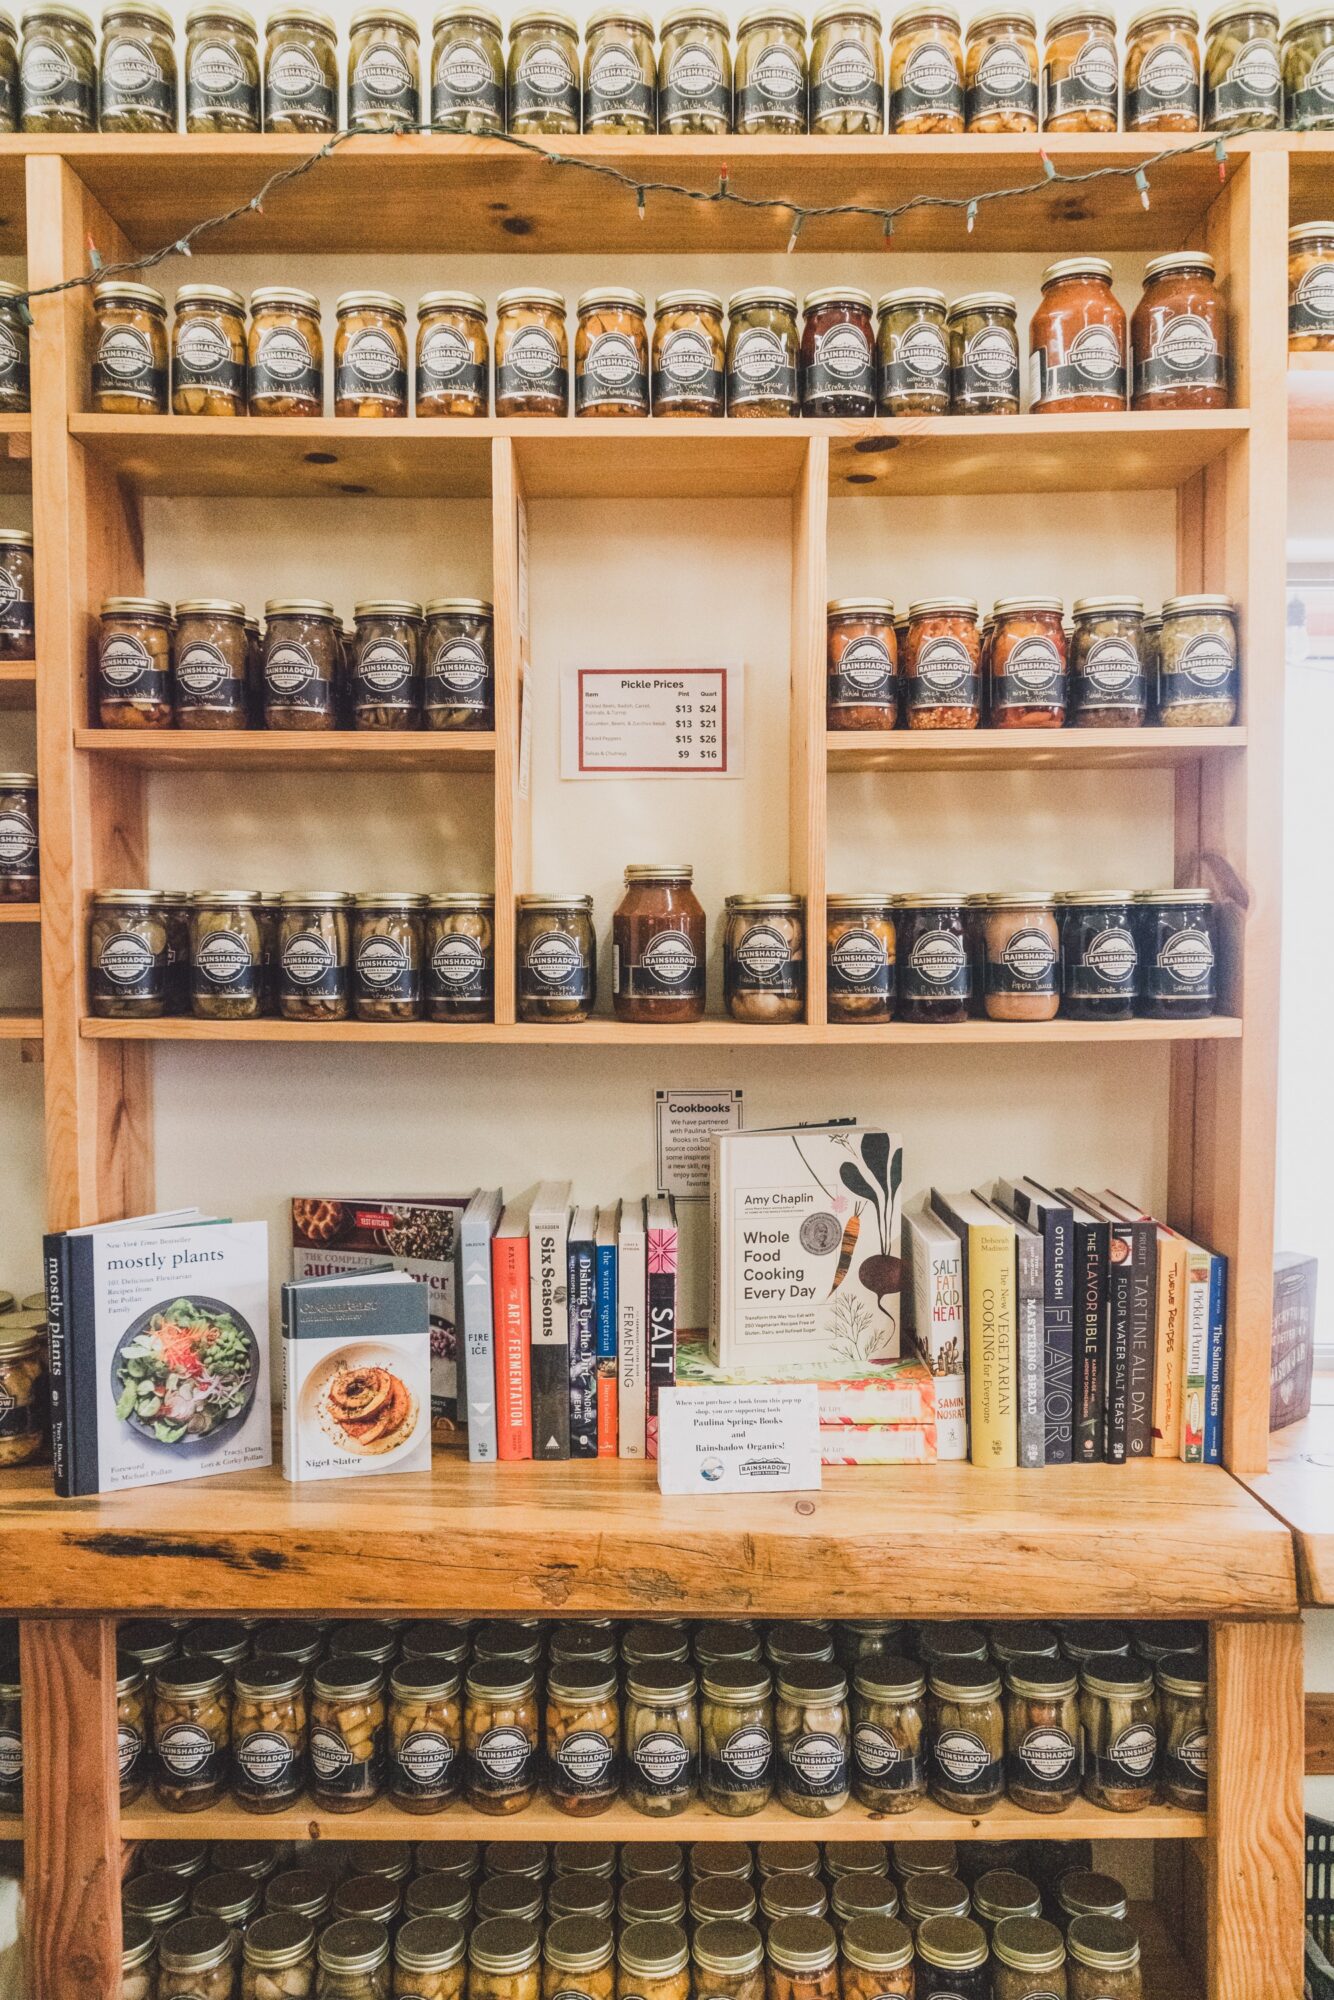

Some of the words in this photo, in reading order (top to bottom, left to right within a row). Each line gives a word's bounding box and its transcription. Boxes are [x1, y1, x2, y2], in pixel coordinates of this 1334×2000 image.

[520, 65, 573, 80] RAINSHADOW
[669, 67, 721, 82] RAINSHADOW
[752, 68, 803, 84] RAINSHADOW
[822, 63, 876, 79] RAINSHADOW
[1158, 339, 1214, 354] RAINSHADOW
[99, 350, 151, 366] RAINSHADOW
[347, 351, 400, 366] RAINSHADOW
[508, 350, 560, 365] RAINSHADOW
[660, 354, 713, 369] RAINSHADOW
[360, 664, 411, 674] RAINSHADOW
[435, 664, 487, 674] RAINSHADOW
[841, 662, 891, 672] RAINSHADOW
[918, 662, 970, 673] RAINSHADOW
[1009, 662, 1060, 672] RAINSHADOW
[1086, 663, 1138, 673] RAINSHADOW
[1181, 659, 1232, 670] RAINSHADOW
[621, 680, 651, 689] Pickle
[653, 680, 684, 689] Prices
[675, 704, 693, 714] $13
[699, 704, 717, 714] $24
[675, 719, 693, 729] $13
[700, 719, 717, 729] $21
[675, 735, 693, 744] $15
[699, 735, 717, 744] $26
[678, 750, 690, 759] $9
[699, 750, 717, 759] $16
[100, 956, 153, 965] RAINSHADOW
[283, 956, 331, 965] RAINSHADOW
[433, 958, 483, 966] RAINSHADOW
[529, 956, 581, 966] RAINSHADOW
[645, 956, 696, 965] RAINSHADOW
[738, 950, 788, 961] RAINSHADOW
[833, 954, 885, 964] RAINSHADOW
[913, 957, 964, 965] RAINSHADOW
[1004, 953, 1054, 962] RAINSHADOW
[1163, 956, 1213, 965] RAINSHADOW
[357, 958, 406, 969] RAINSHADOW
[669, 1104, 731, 1113] Cookbooks
[744, 1195, 770, 1207] Amy
[772, 1193, 814, 1205] Chaplin
[371, 1219, 390, 1228] KITCHEN
[743, 1231, 790, 1244] Whole
[1087, 1231, 1096, 1252] THE
[540, 1236, 555, 1265] Six
[603, 1251, 612, 1265] the
[744, 1250, 781, 1263] Food
[108, 1252, 166, 1270] mostly
[172, 1249, 225, 1269] plants
[304, 1252, 322, 1262] THE
[324, 1253, 374, 1266] COMPLETE
[1054, 1226, 1064, 1300] OTTOLENGHI
[932, 1258, 960, 1276] SALT
[578, 1258, 592, 1305] Dishing
[743, 1268, 805, 1282] Cooking
[1000, 1267, 1009, 1286] The
[1085, 1254, 1098, 1311] FLAVOR
[50, 1257, 63, 1316] mostly
[603, 1270, 612, 1300] winter
[936, 1275, 958, 1291] FAT
[744, 1287, 786, 1301] Every
[790, 1285, 817, 1300] Day
[935, 1290, 960, 1306] ACID
[1000, 1288, 1009, 1310] New
[1118, 1278, 1127, 1317] FLOUR
[541, 1268, 556, 1337] Seasons
[1192, 1288, 1205, 1331] Pickled
[507, 1303, 521, 1325] ART
[578, 1308, 592, 1326] Up
[933, 1305, 962, 1322] HEAT
[1133, 1275, 1149, 1350] TARTINE
[600, 1304, 612, 1352] vegetarian
[982, 1288, 995, 1362] COOKING
[1212, 1324, 1223, 1340] The
[468, 1334, 489, 1342] FIRE
[581, 1330, 592, 1349] the
[651, 1307, 674, 1374] SALT
[1027, 1298, 1037, 1370] MASTERING
[1085, 1313, 1098, 1354] BIBLE
[1116, 1320, 1126, 1361] WATER
[50, 1320, 64, 1376] plants
[472, 1347, 487, 1355] ICE
[623, 1306, 634, 1388] FERMENTING
[1189, 1333, 1203, 1375] Pantry
[581, 1351, 592, 1377] Dirt
[999, 1312, 1011, 1416] VEGETARIAN
[1211, 1341, 1222, 1382] Salmon
[983, 1363, 993, 1377] for
[1044, 1305, 1073, 1448] FLAVOR
[1115, 1363, 1125, 1391] SALT
[1132, 1354, 1146, 1386] ALL
[508, 1339, 523, 1428] FERMENTATION
[982, 1379, 993, 1424] Everyone
[1027, 1374, 1037, 1416] BREAD
[1210, 1384, 1221, 1417] Sisters
[573, 1394, 582, 1420] BEMIS
[583, 1389, 592, 1424] ANDREA
[938, 1398, 964, 1409] SAMIN
[1131, 1391, 1145, 1425] DAY
[937, 1408, 966, 1421] NOSRAT
[1114, 1395, 1124, 1432] YEAST
[693, 1418, 725, 1426] Paulina
[727, 1418, 758, 1427] Springs
[759, 1417, 783, 1425] Books
[695, 1444, 744, 1452] Rainshadow
[746, 1442, 785, 1452] Organics!
[306, 1458, 330, 1469] Nigel
[333, 1457, 362, 1466] Slater
[741, 1464, 788, 1472] RAINSHADOW
[160, 1744, 212, 1755] RAINSHADOW
[478, 1748, 529, 1758] RAINSHADOW
[559, 1752, 611, 1762] RAINSHADOW
[1022, 1750, 1073, 1759] RAINSHADOW
[239, 1753, 292, 1762] RAINSHADOW
[636, 1753, 687, 1762] RAINSHADOW
[792, 1754, 843, 1764] RAINSHADOW
